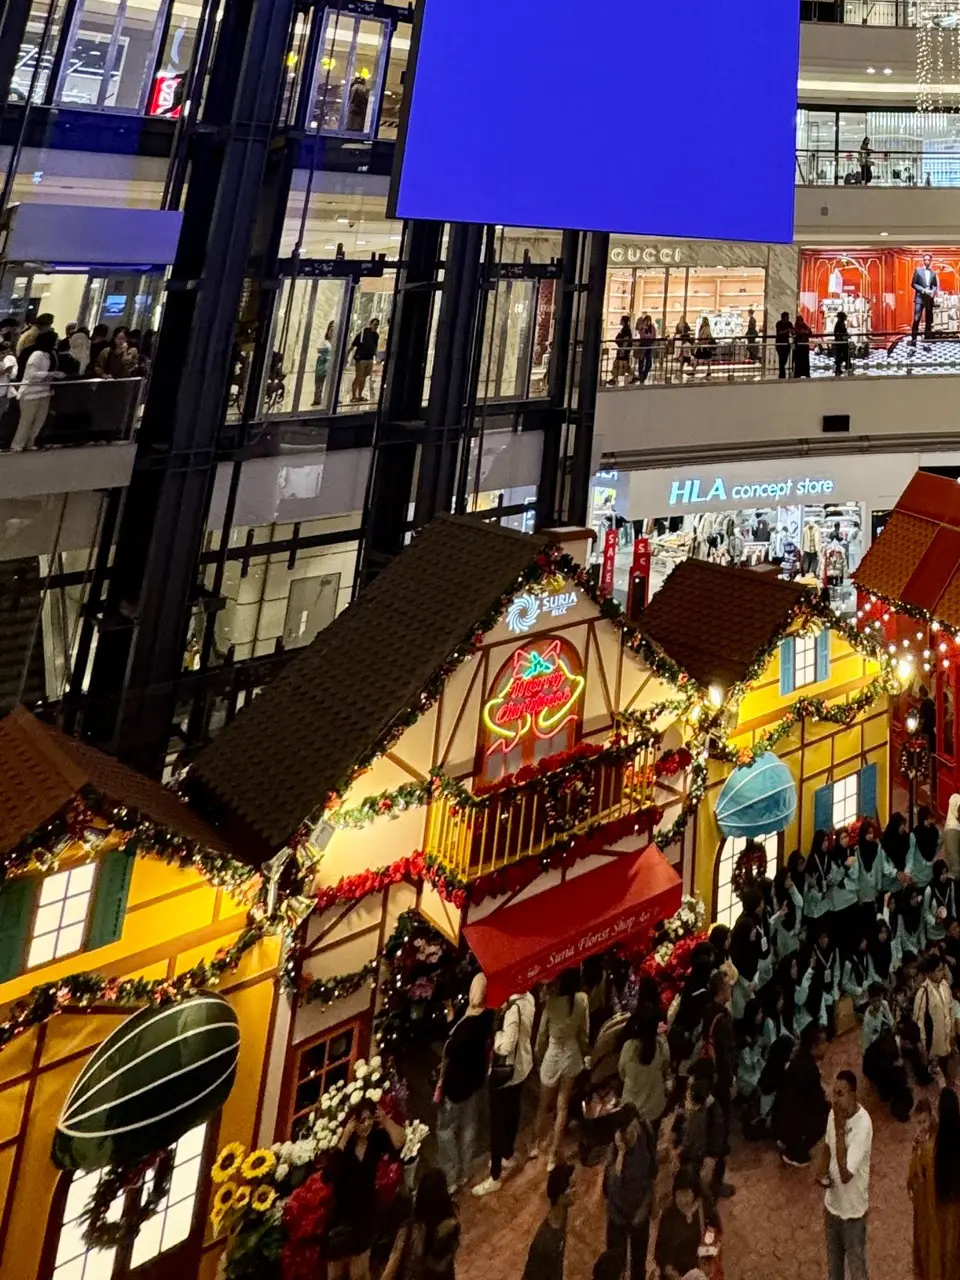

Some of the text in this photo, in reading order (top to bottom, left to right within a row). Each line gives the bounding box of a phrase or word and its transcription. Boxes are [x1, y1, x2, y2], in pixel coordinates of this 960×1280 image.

[610, 247, 681, 262] GUCCI
[668, 477, 834, 506] HLA concept store
[604, 533, 615, 583] SALE
[542, 591, 577, 610] SURIA
[510, 671, 566, 699] Merry
[496, 687, 572, 724] Christmas
[546, 916, 636, 968] Suria Florist Shop
